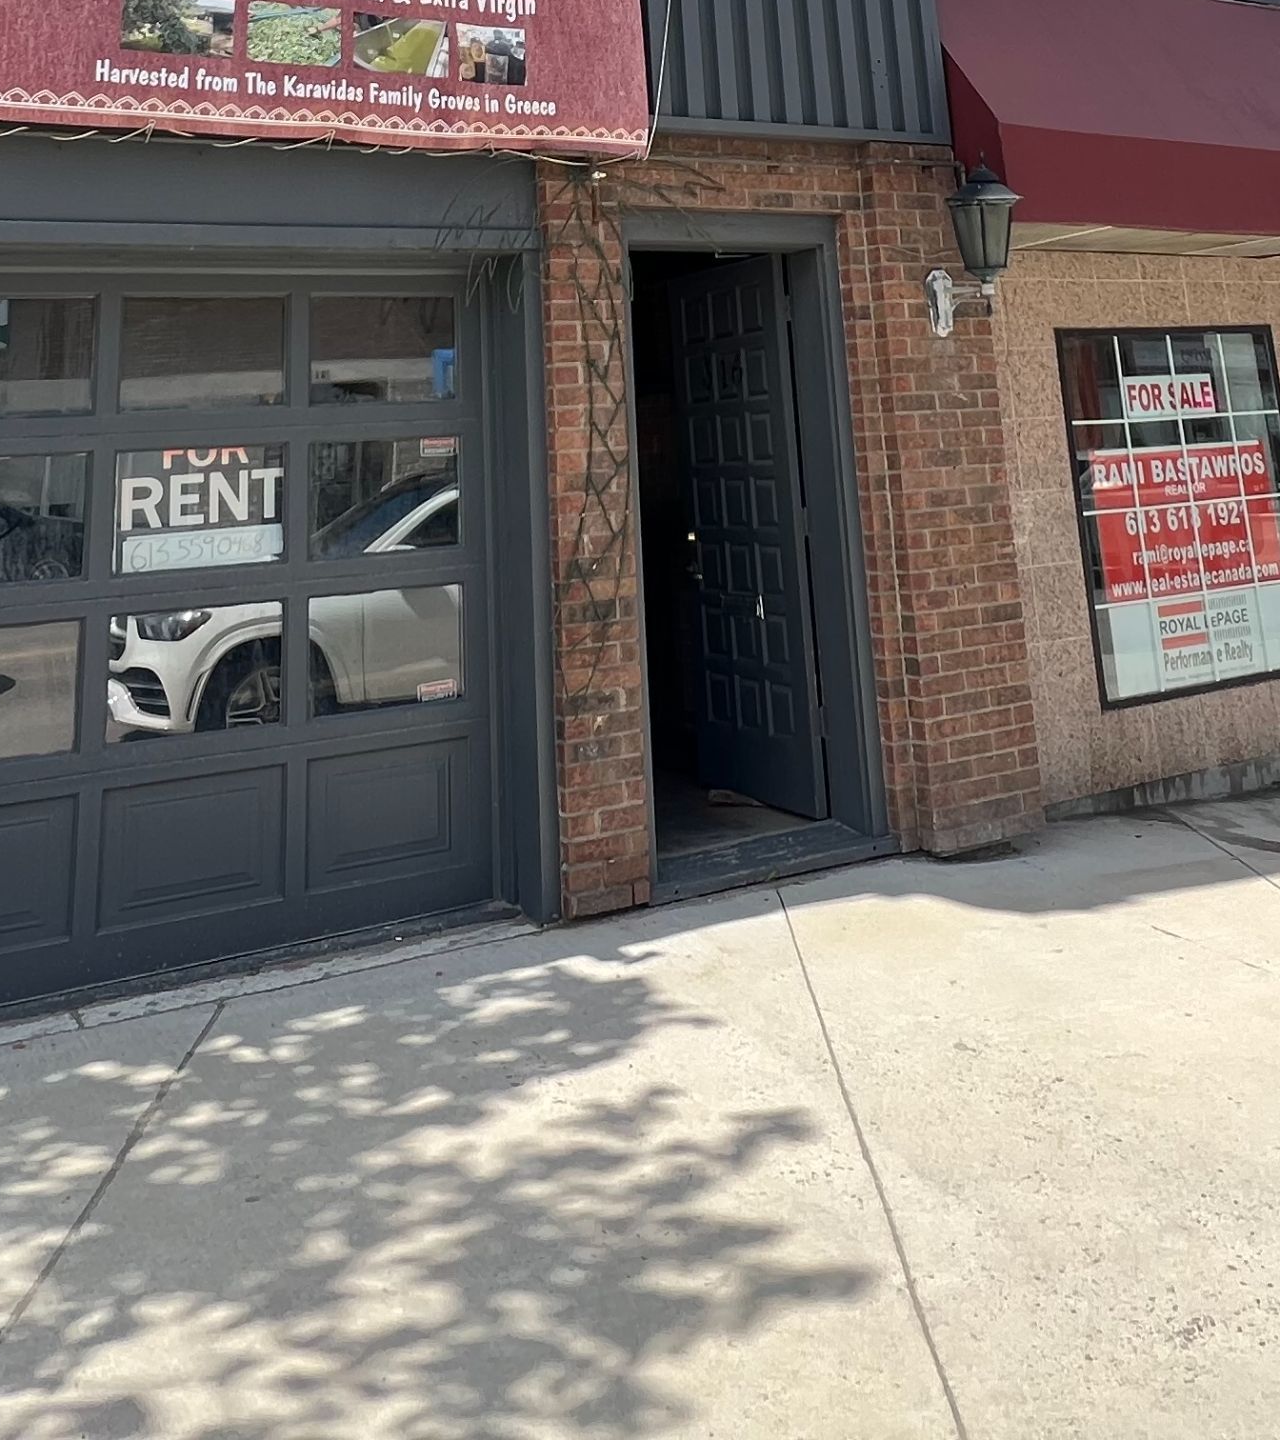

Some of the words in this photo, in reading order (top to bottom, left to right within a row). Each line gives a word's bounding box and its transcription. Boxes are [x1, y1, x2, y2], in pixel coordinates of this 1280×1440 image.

[95, 59, 189, 90] Harvested
[196, 67, 238, 93] from
[245, 71, 277, 96] The
[283, 75, 364, 103] Karavidas
[370, 82, 422, 111] Family
[428, 88, 481, 111] Groves
[485, 94, 499, 113] in
[505, 93, 556, 116] Greece
[1126, 384, 1164, 412] FOR
[1167, 381, 1213, 411] SALE
[1093, 461, 1145, 485] RAMI
[1150, 452, 1266, 484] BASTAWROS
[120, 467, 285, 531] RENT
[1165, 482, 1206, 496] REALOR
[1125, 508, 1161, 536] 613
[1167, 504, 1202, 532] 618
[1132, 538, 1252, 566] rami@royalepage.ca
[1111, 562, 1280, 598] www.eal-estaecanadacom
[1159, 615, 1201, 636] ROYAL
[1163, 648, 1223, 672] Performane
[1224, 639, 1253, 662] Realty
